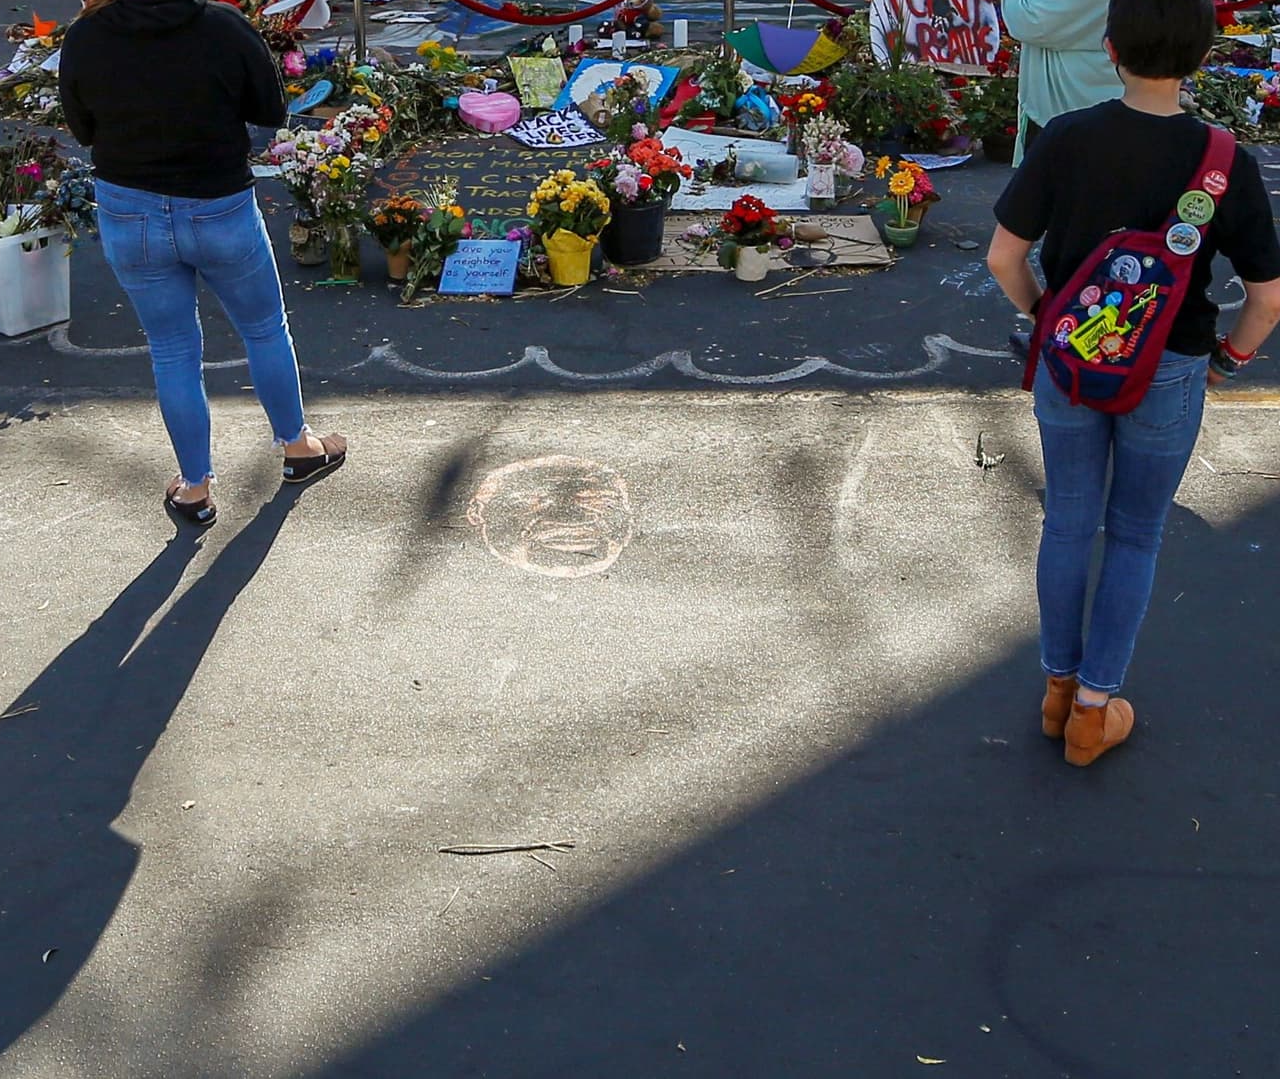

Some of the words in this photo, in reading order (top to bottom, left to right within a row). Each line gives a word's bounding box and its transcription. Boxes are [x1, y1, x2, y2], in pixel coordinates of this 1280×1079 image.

[511, 108, 572, 132] BLACK
[490, 160, 553, 169] MUST
[489, 247, 513, 257] your
